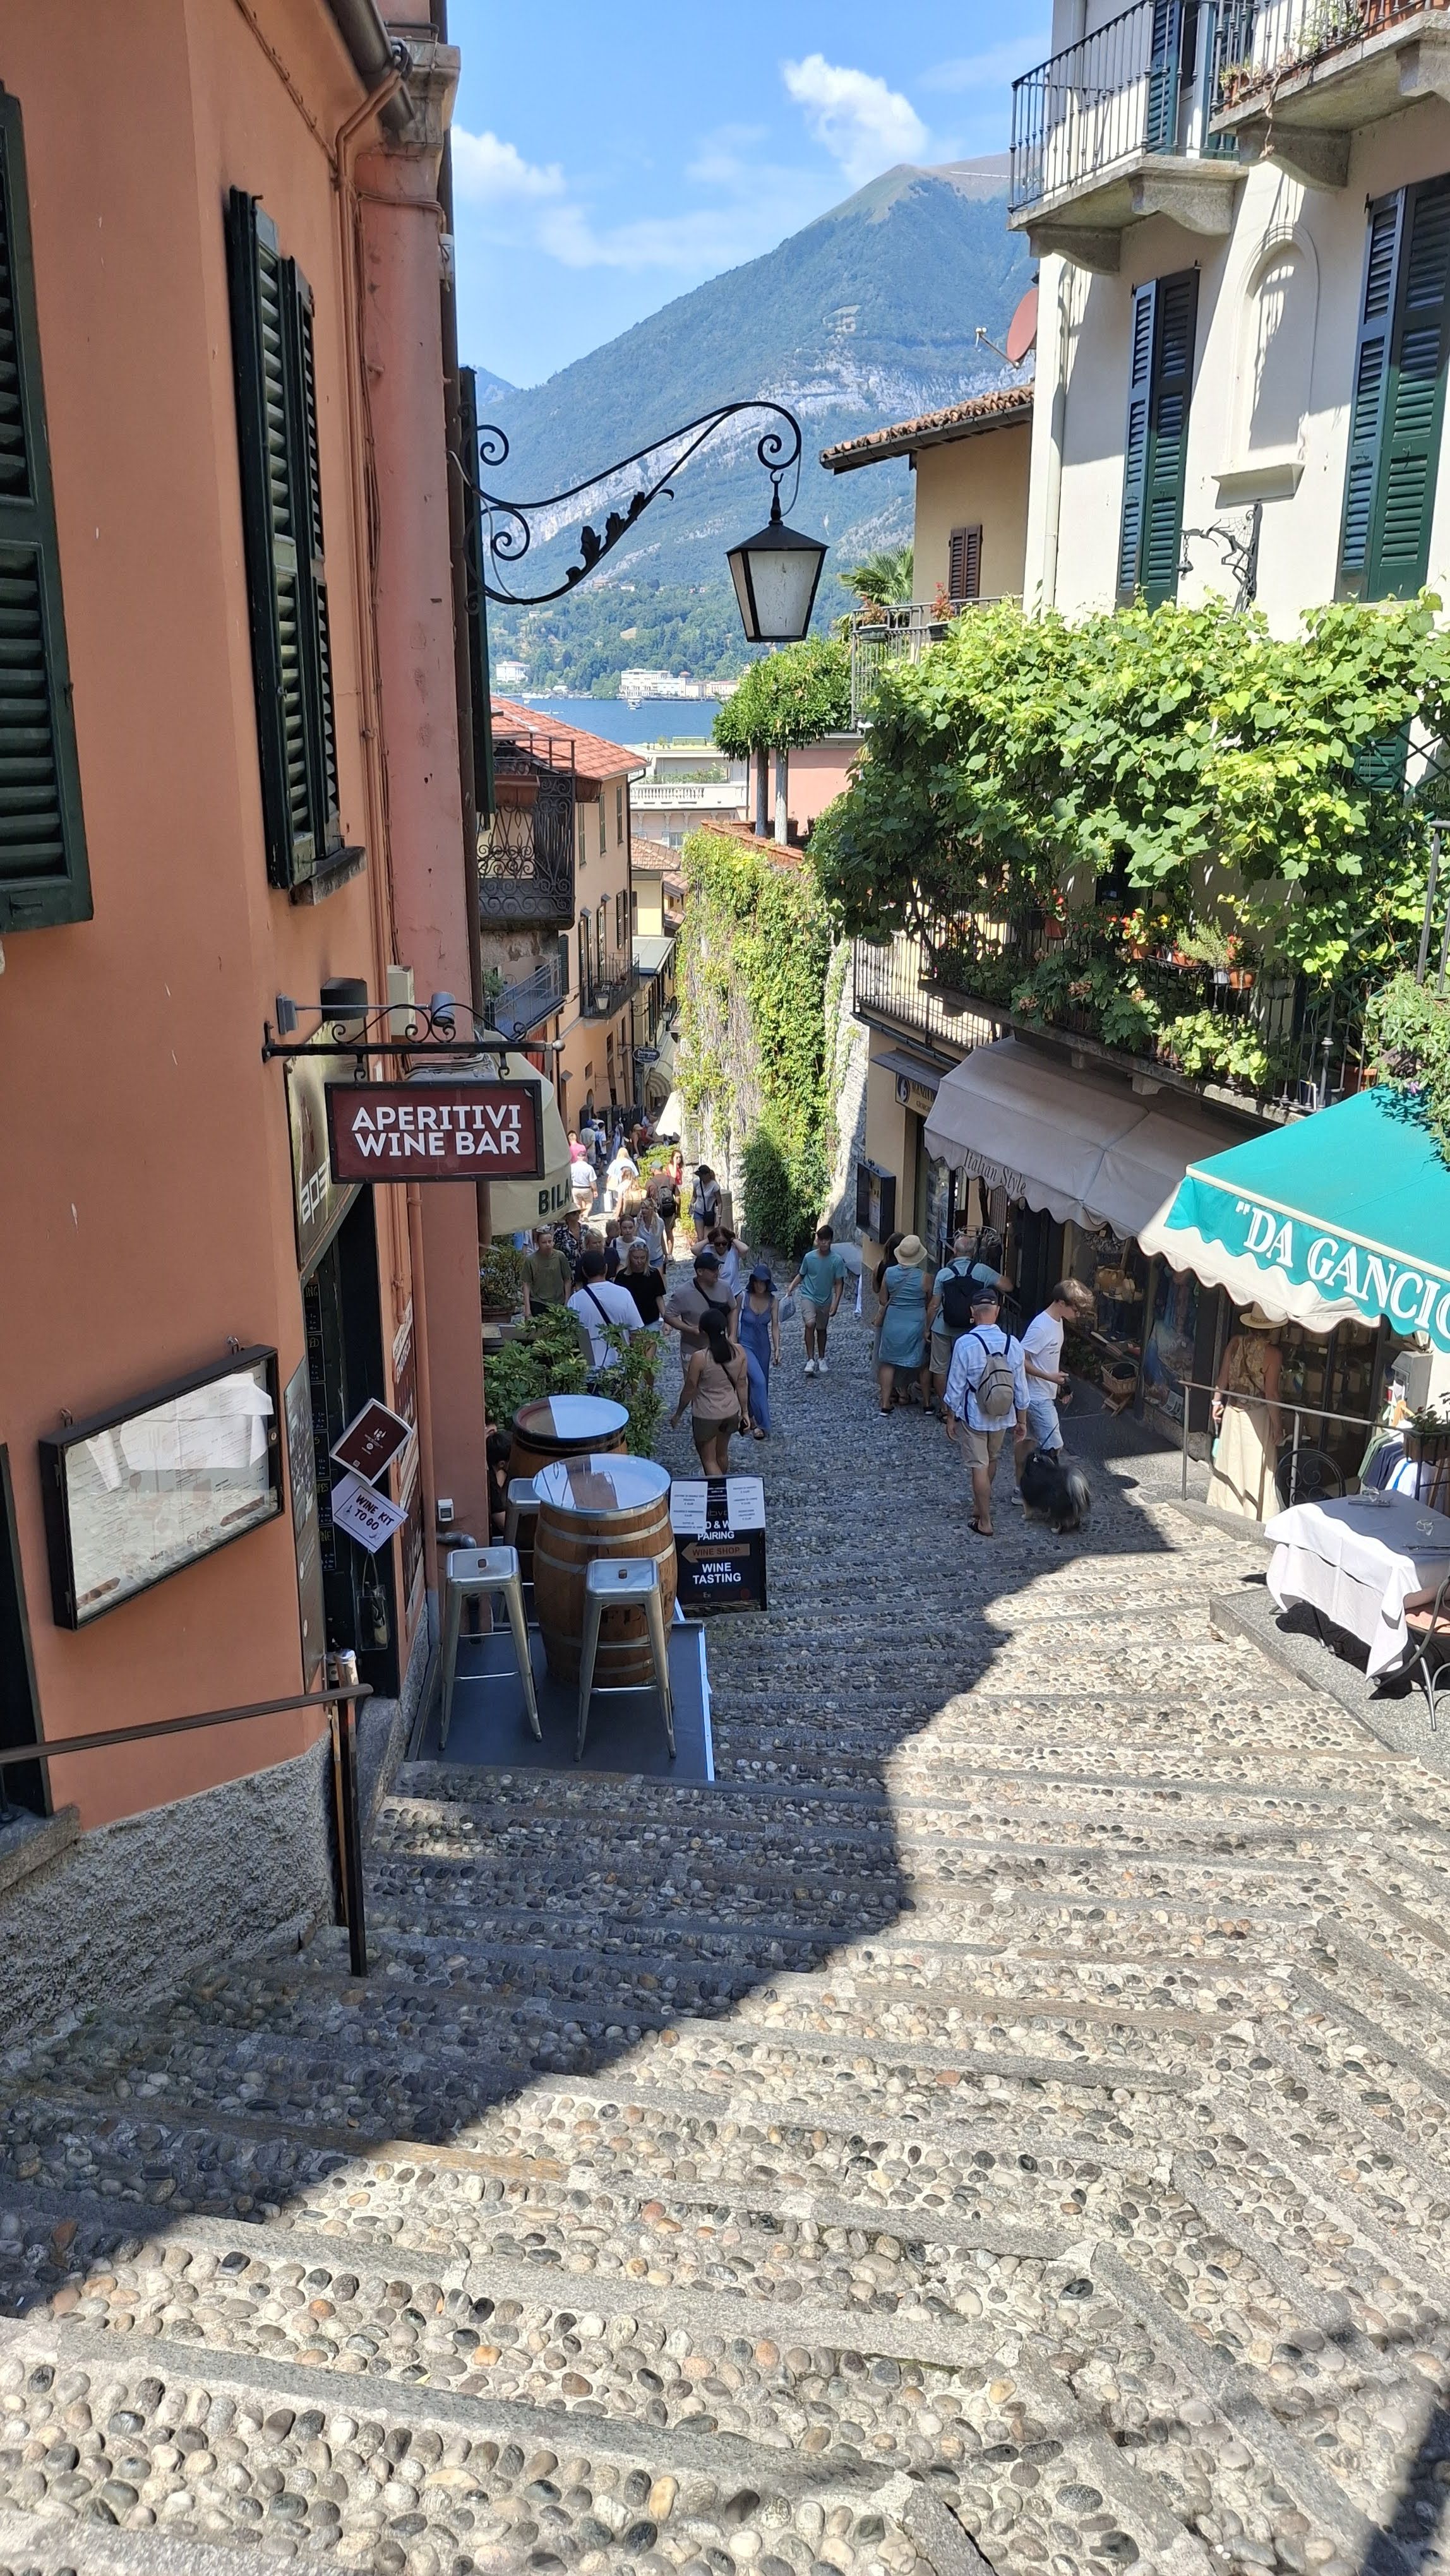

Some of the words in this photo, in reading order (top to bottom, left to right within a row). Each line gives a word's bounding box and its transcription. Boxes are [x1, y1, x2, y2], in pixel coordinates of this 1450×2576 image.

[352, 1105, 522, 1131] APERITIVI
[354, 1132, 445, 1157] WINE
[455, 1131, 521, 1155] BAR
[964, 1150, 997, 1182] Italian
[1000, 1166, 1026, 1197] Style
[354, 1508, 367, 1521] TO
[366, 1518, 379, 1530] GO
[356, 1494, 378, 1514] WINE
[378, 1512, 394, 1526] KIT
[697, 1531, 735, 1541] PAIRING
[692, 1547, 714, 1556] WINE
[716, 1547, 740, 1555] SHOP
[692, 1572, 741, 1584] TASTING
[702, 1562, 731, 1573] WINE
